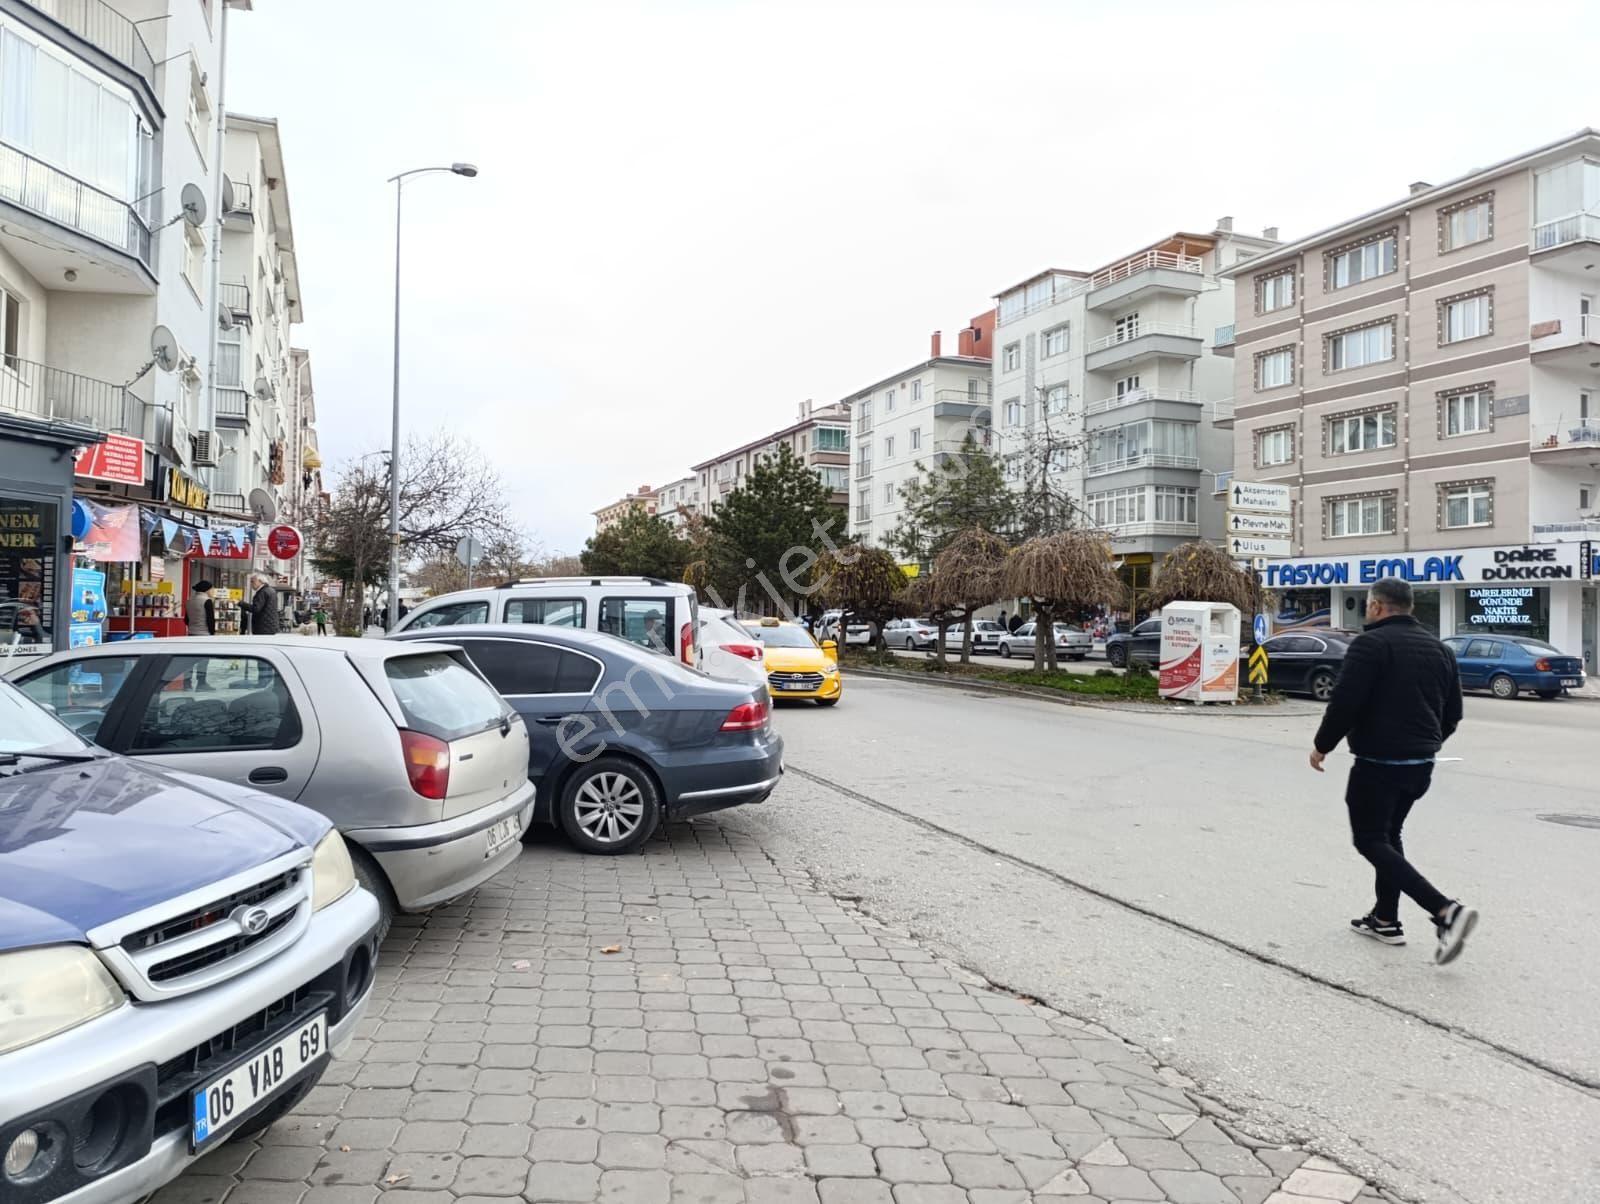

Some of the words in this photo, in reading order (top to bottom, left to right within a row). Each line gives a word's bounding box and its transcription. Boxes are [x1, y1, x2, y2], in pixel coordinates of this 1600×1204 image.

[1243, 497, 1278, 506] Mahallesi
[1242, 541, 1265, 551] Ulus
[1494, 546, 1557, 563] DAİRE
[1359, 555, 1464, 583] EMLAK
[1482, 564, 1572, 580] DÜKKAN
[209, 1078, 234, 1126] 06
[249, 1046, 283, 1098] VAB
[300, 1023, 319, 1062] 69
[196, 1117, 207, 1132] TR
